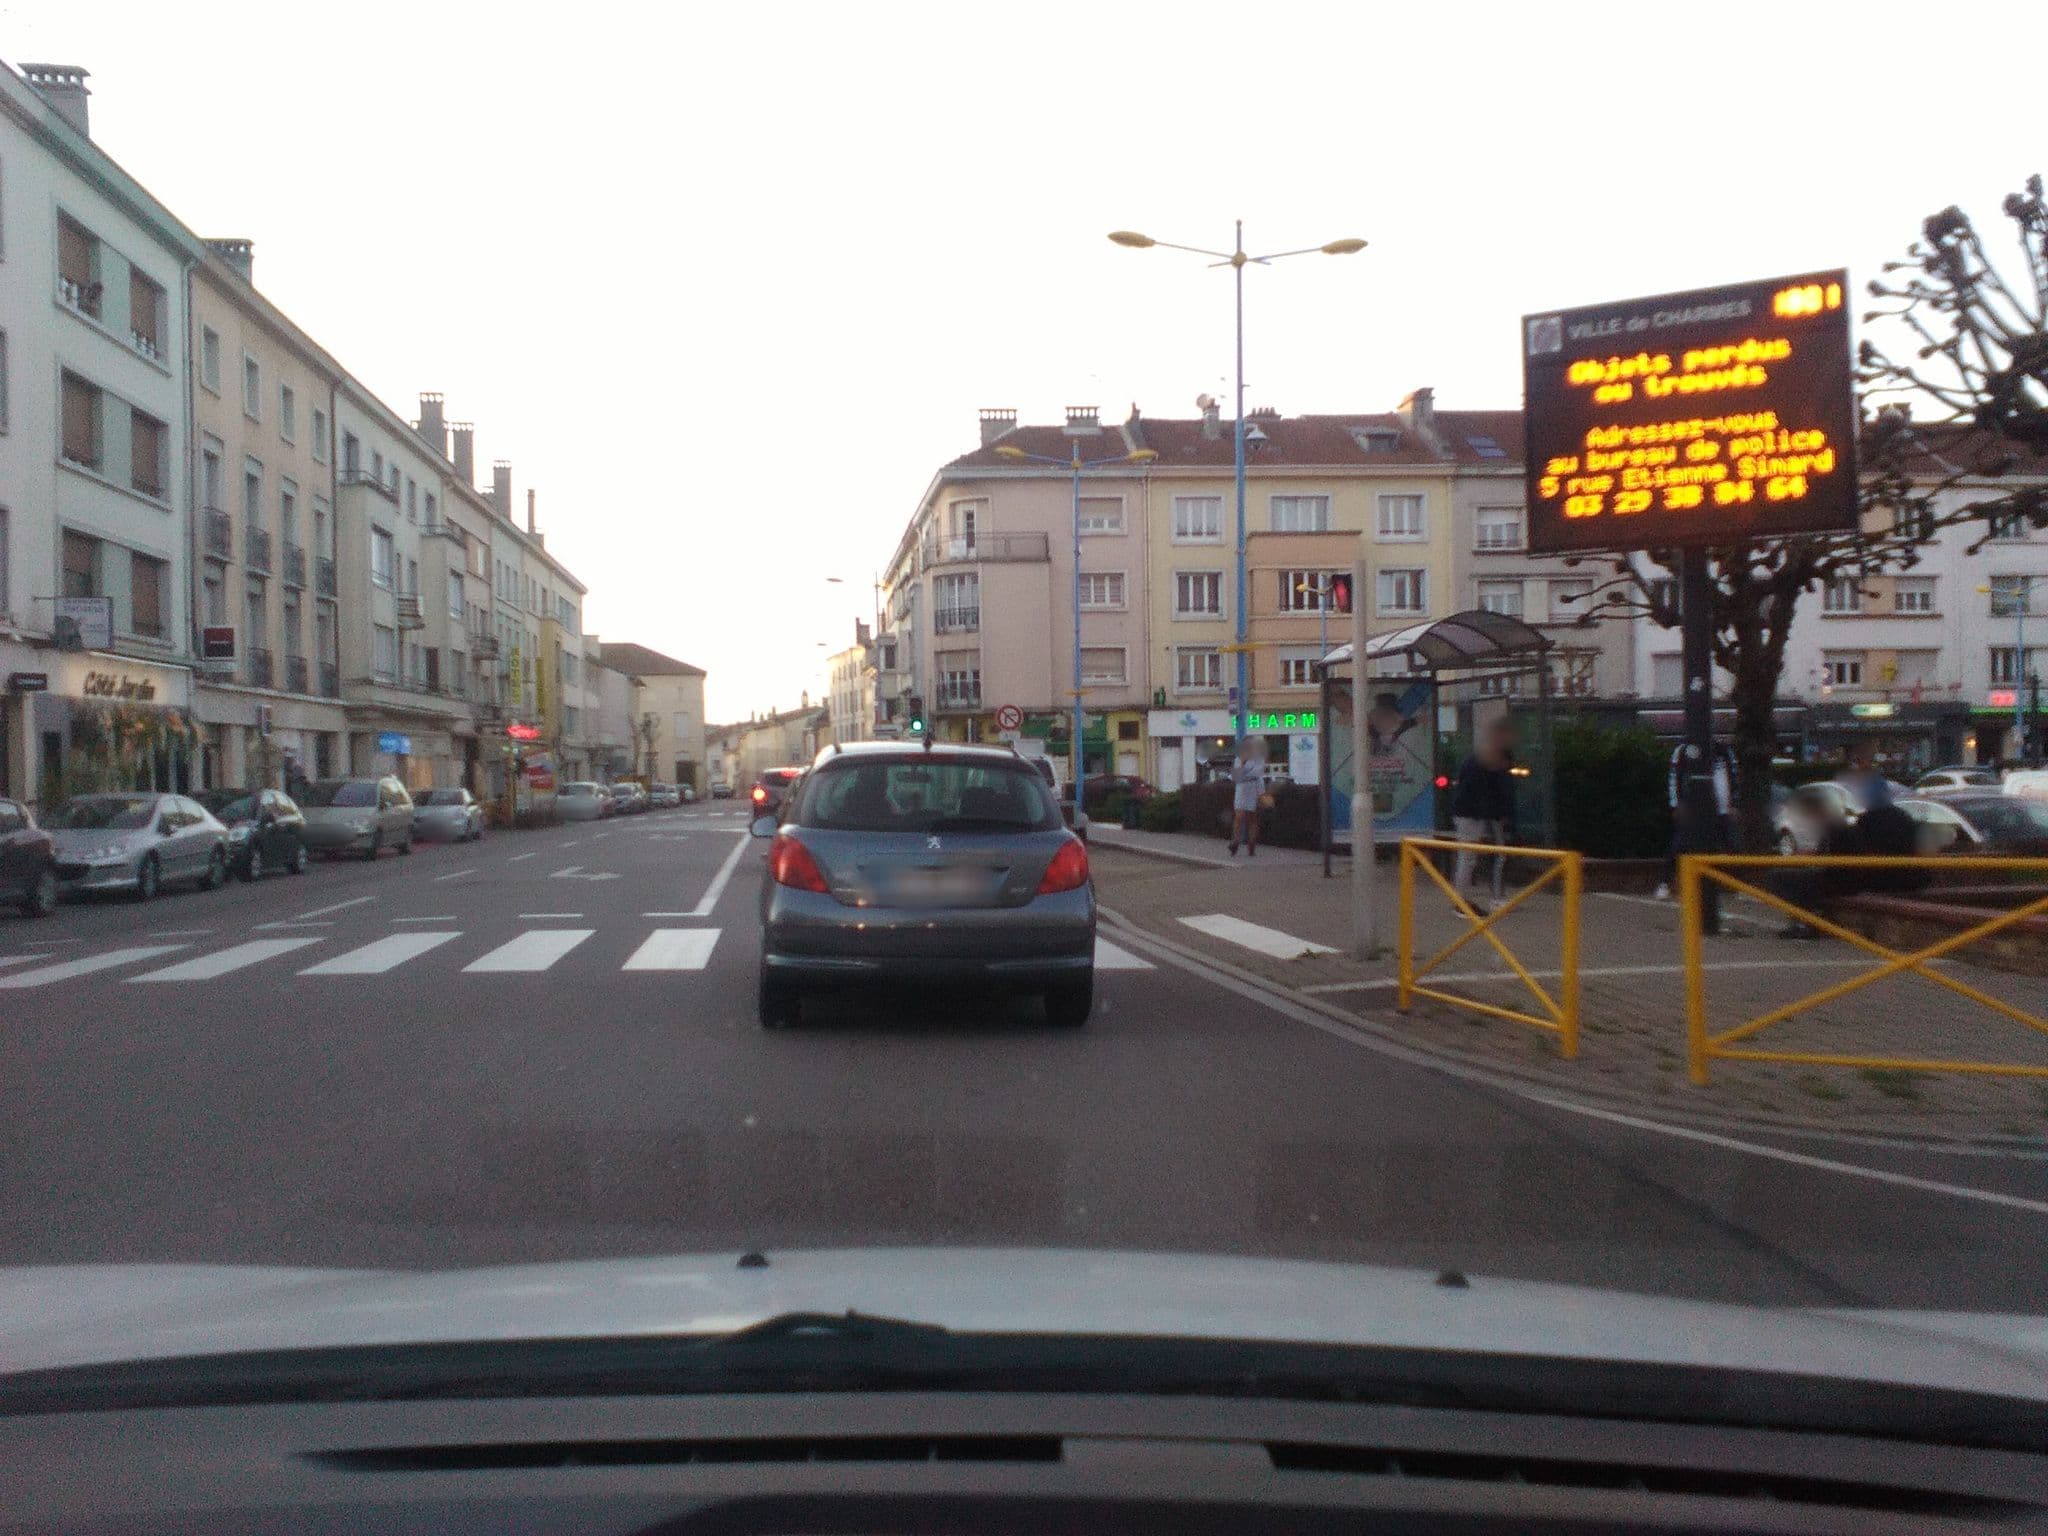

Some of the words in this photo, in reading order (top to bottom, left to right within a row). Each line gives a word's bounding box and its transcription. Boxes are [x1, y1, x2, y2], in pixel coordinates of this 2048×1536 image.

[1683, 338, 1792, 371] perdus
[1594, 382, 1633, 404] ou
[1586, 445, 1677, 471] bureau
[1686, 438, 1720, 461] de
[1729, 428, 1825, 458] police
[1567, 475, 1614, 494] rue
[1622, 463, 1727, 490] Etienne
